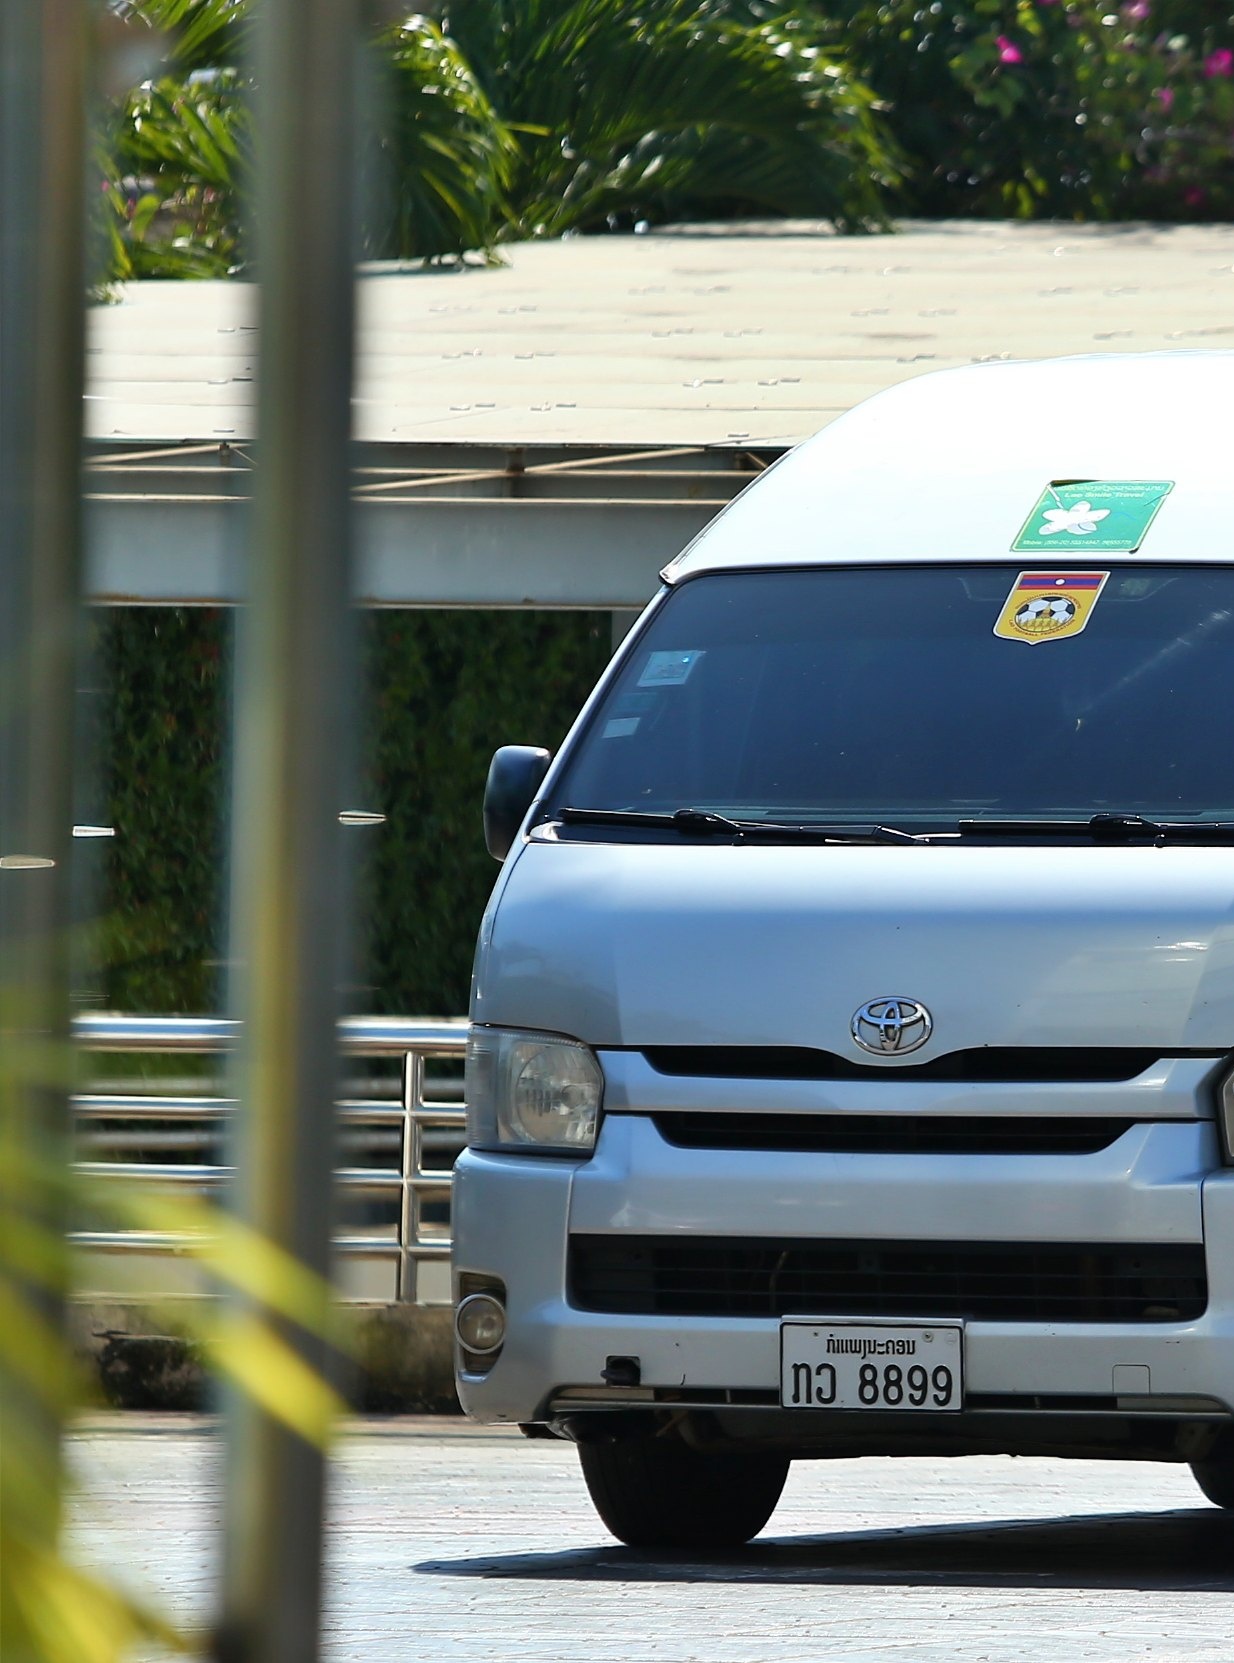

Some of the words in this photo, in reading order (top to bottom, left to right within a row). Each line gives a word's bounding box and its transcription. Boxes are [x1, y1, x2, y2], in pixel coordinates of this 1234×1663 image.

[826, 1333, 916, 1359] ກຳແພງນະຄອນ
[791, 1362, 837, 1404] ກວ
[858, 1363, 953, 1407] 8899
